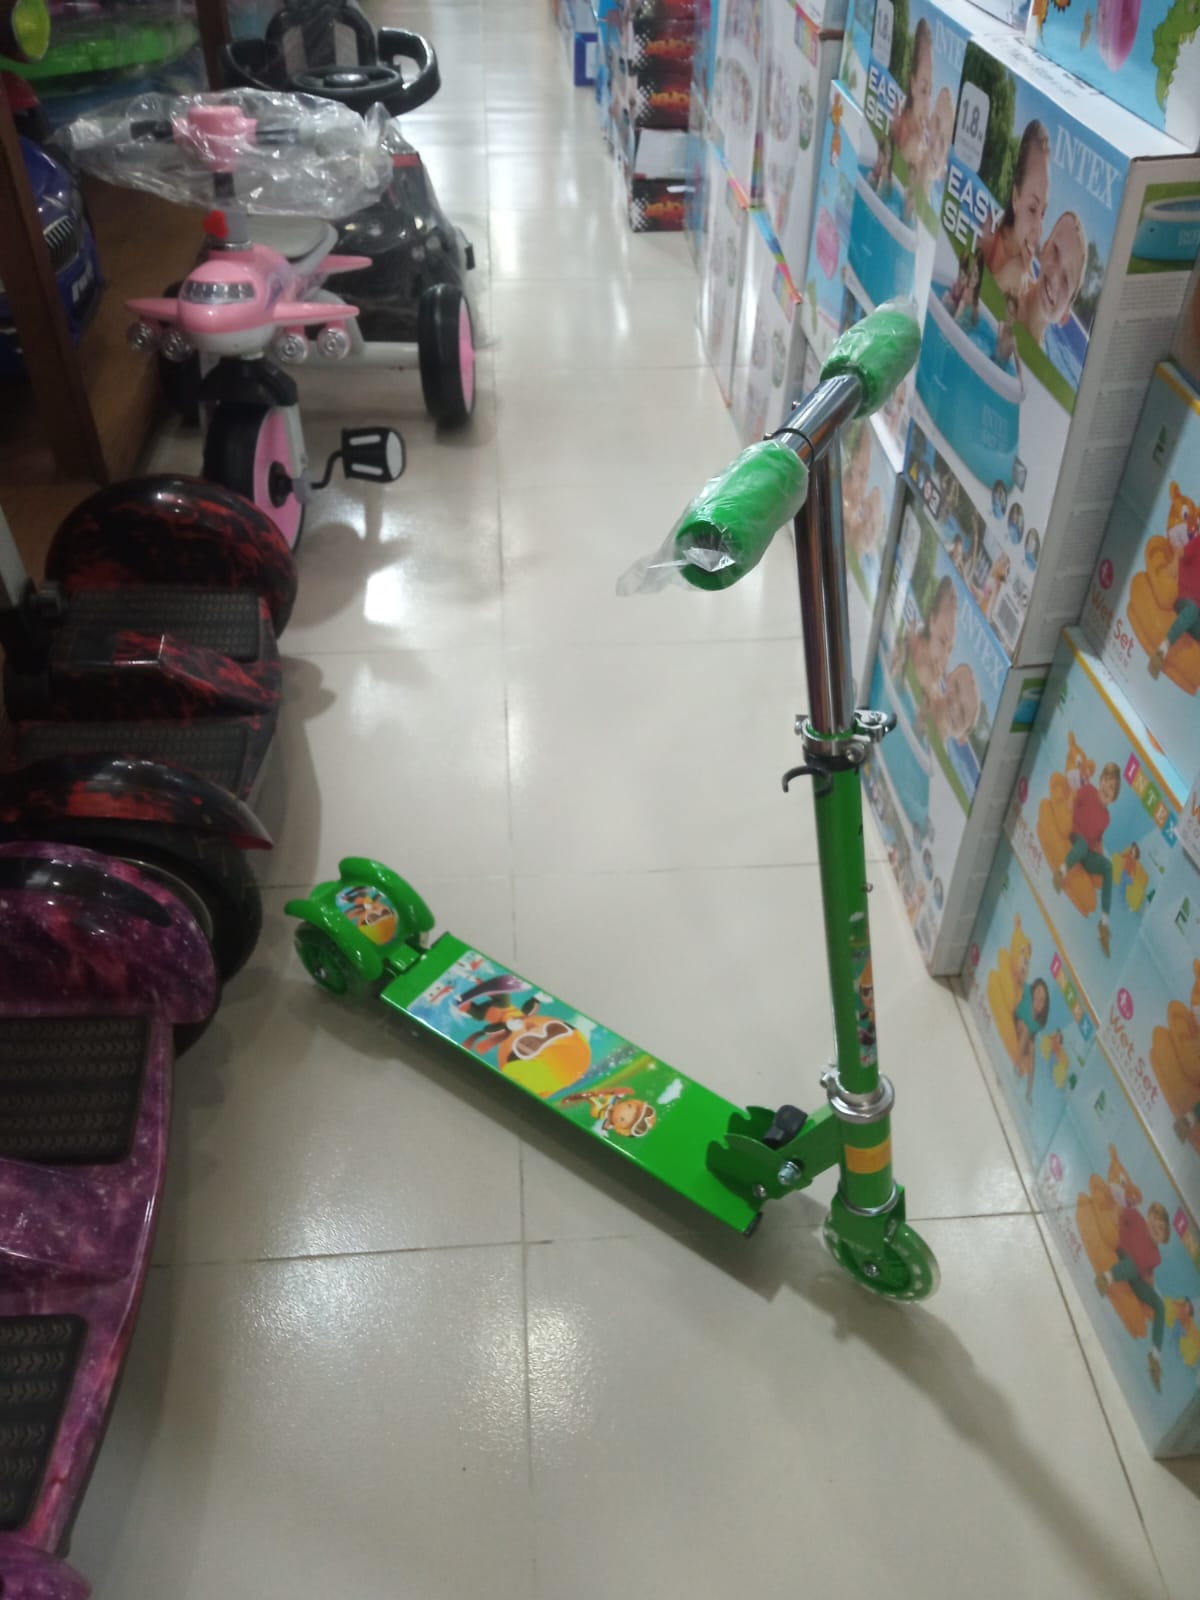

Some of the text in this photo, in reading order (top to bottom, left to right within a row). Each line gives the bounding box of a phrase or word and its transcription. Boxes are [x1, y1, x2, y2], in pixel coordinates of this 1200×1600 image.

[865, 94, 896, 136] SET
[868, 65, 908, 117] EASY
[1055, 125, 1120, 210] INTEX
[943, 200, 983, 254] SET
[947, 164, 1005, 234] EASY
[1113, 618, 1135, 660] Set
[1126, 757, 1178, 844] INTEX
[1108, 1002, 1158, 1105] Wet Set
